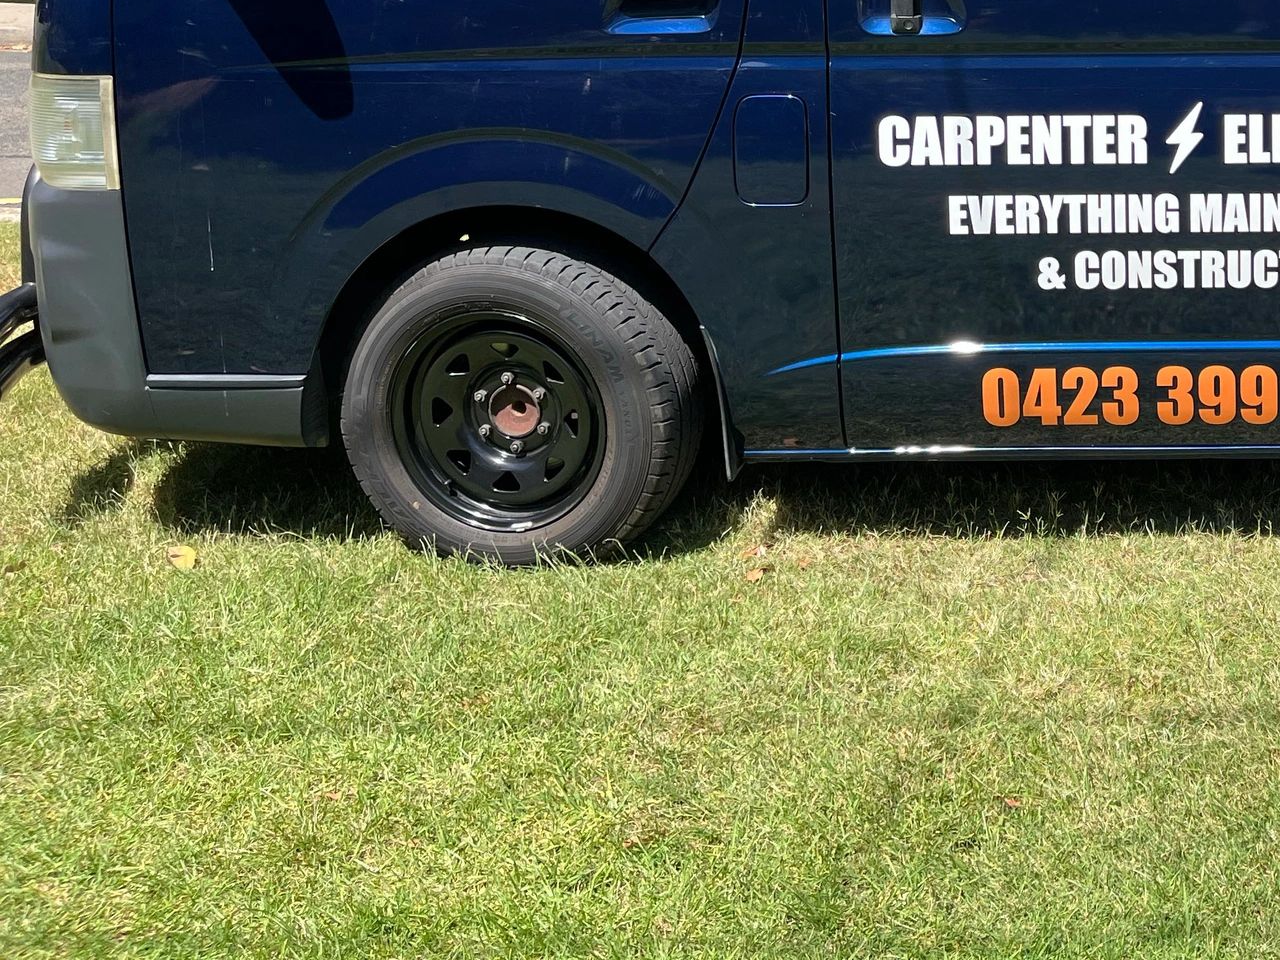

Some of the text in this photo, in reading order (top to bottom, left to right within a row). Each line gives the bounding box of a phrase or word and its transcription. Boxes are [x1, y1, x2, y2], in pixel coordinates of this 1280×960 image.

[877, 114, 1148, 168] CARPENTER
[948, 192, 1180, 236] EVERYTHING
[1037, 256, 1067, 290] &
[982, 366, 1140, 427] 0423
[1156, 365, 1279, 426] 399
